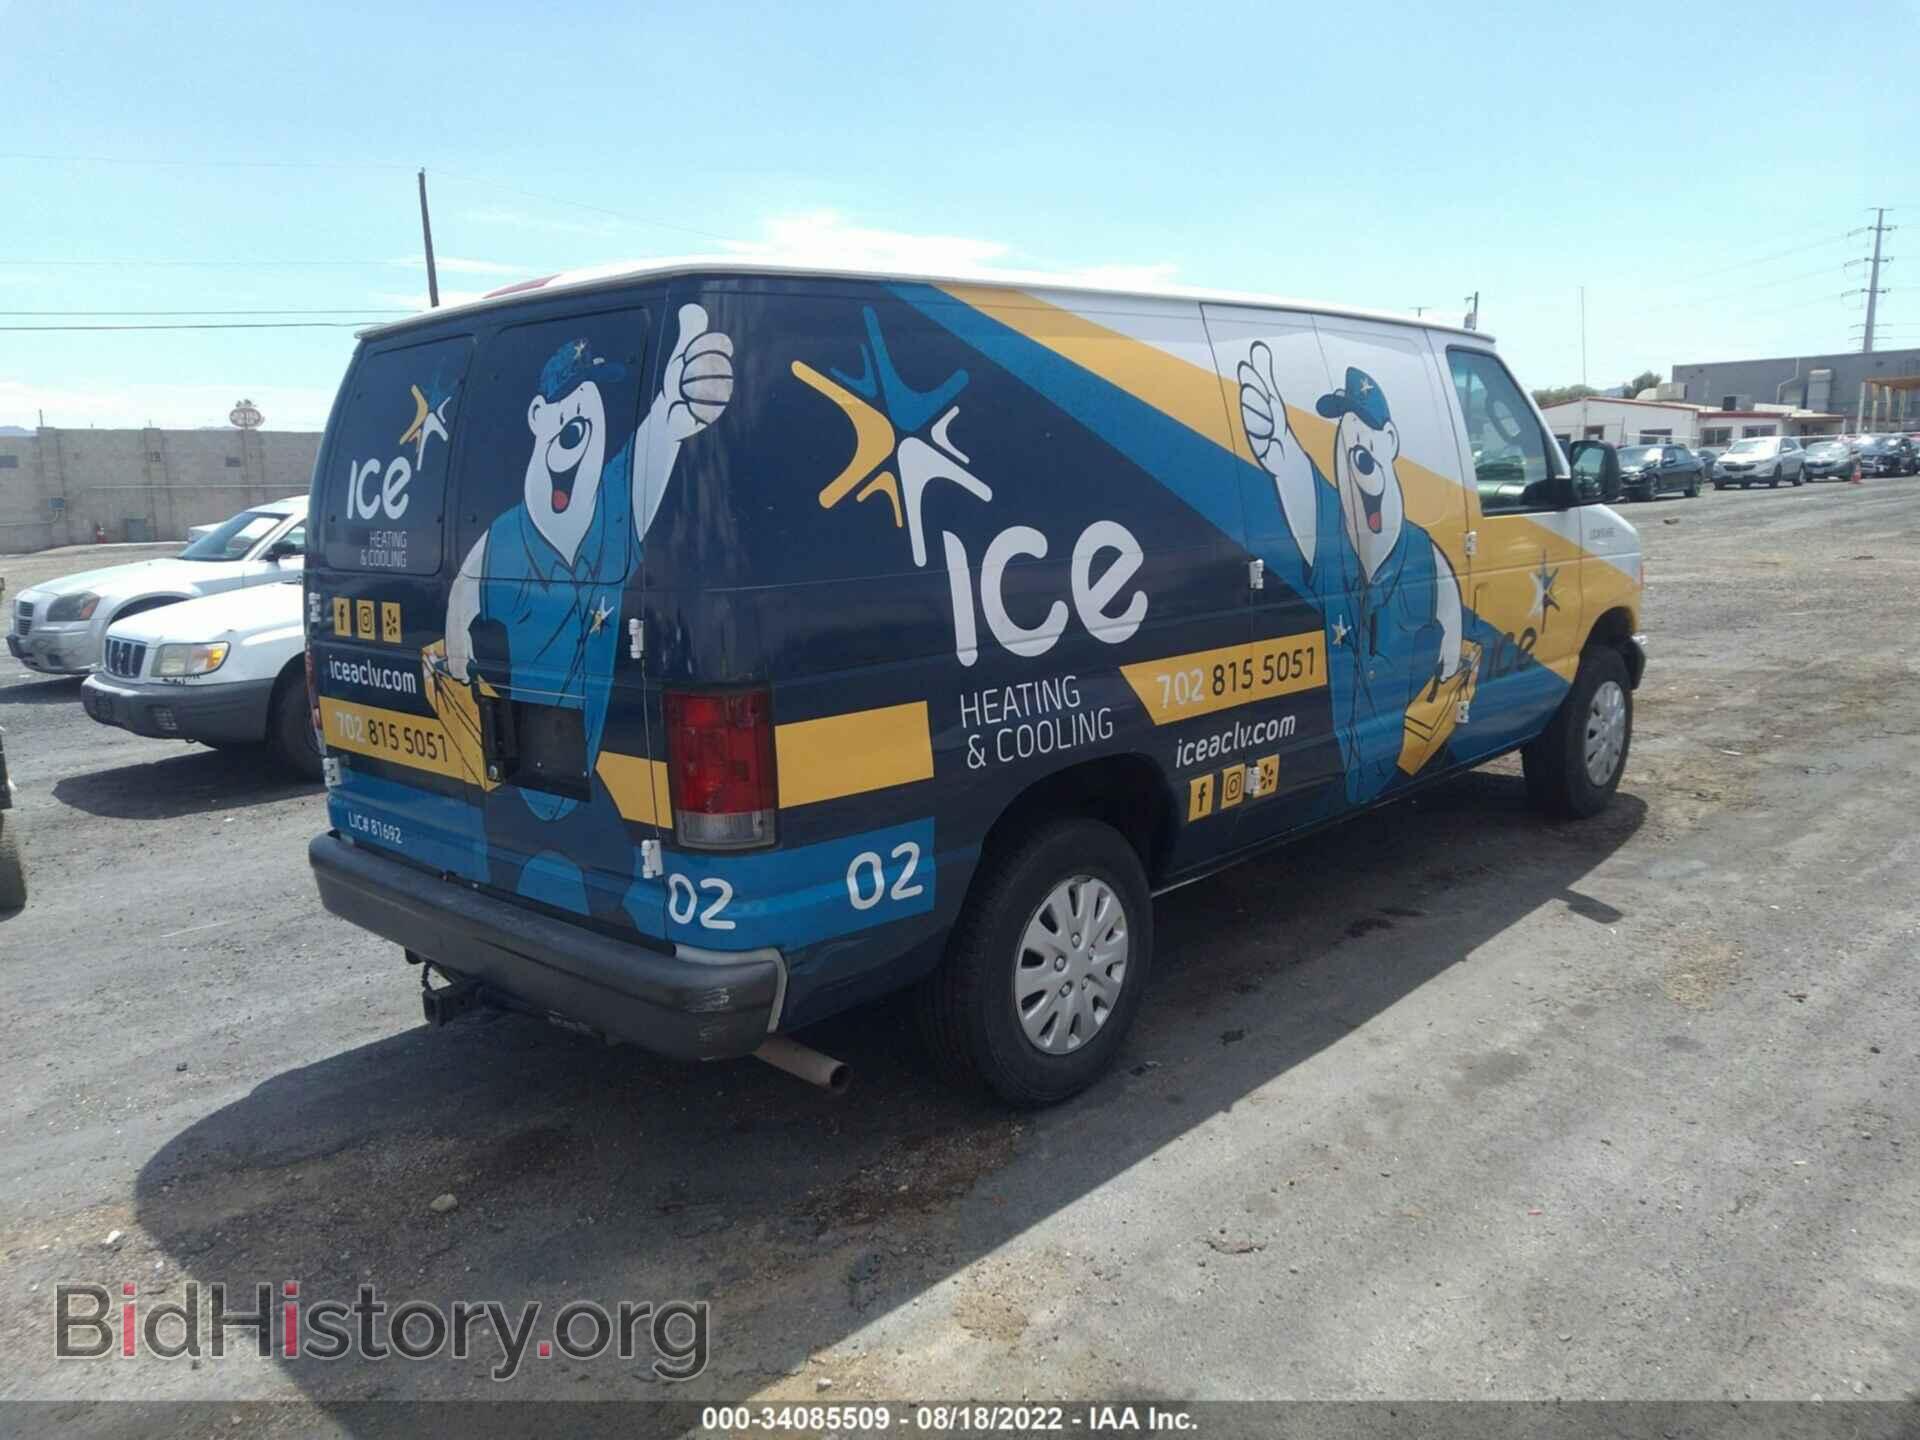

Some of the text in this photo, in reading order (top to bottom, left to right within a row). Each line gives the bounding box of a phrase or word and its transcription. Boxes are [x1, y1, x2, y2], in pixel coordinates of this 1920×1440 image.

[360, 549, 407, 568] & COOLING
[369, 531, 407, 548] HEATING
[328, 653, 416, 694] iceaclv.com
[1157, 647, 1314, 709] 702 815 5051
[960, 675, 1081, 728] HEATING
[335, 711, 449, 763] 702 815 5051
[967, 707, 1113, 769] & COOLING
[1176, 715, 1296, 768] iceaclv.com
[348, 811, 403, 844] LIC# 81692
[668, 873, 736, 930] 02
[847, 841, 923, 911] 02
